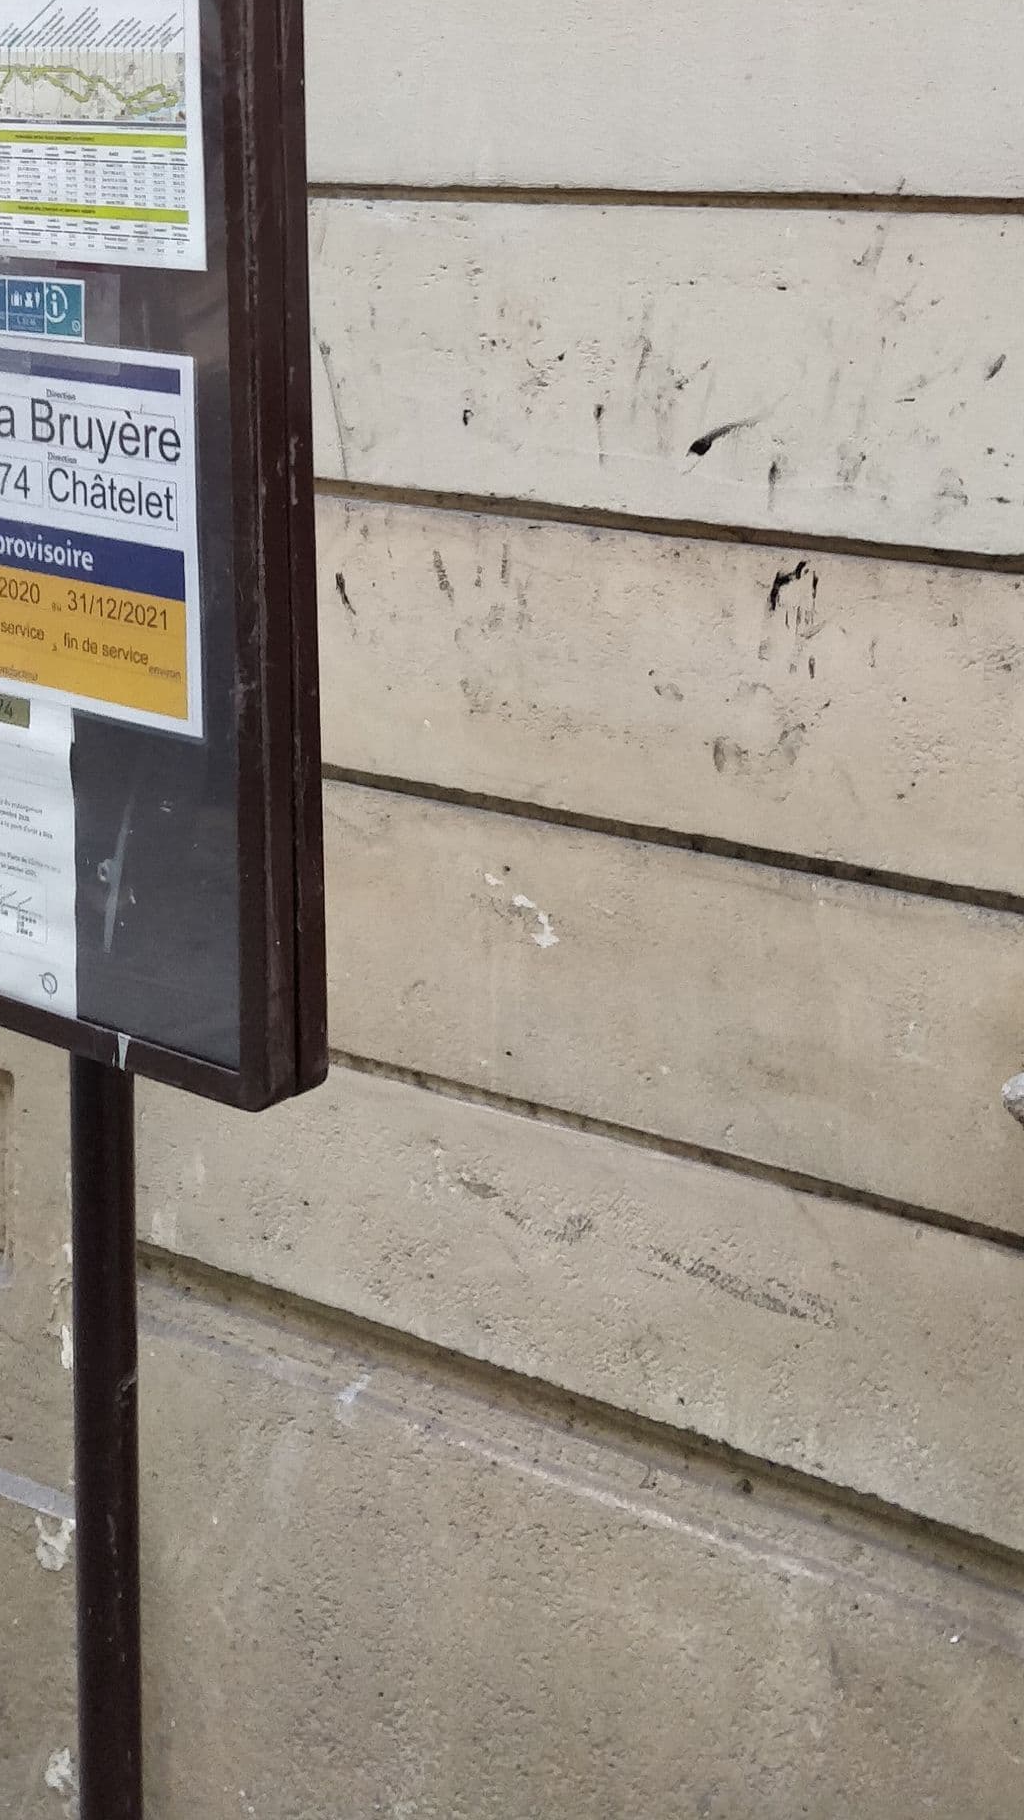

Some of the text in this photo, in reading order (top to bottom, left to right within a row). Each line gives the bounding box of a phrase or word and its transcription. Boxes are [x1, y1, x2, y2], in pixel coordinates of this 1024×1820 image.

[30, 397, 181, 464] Bruyère
[48, 467, 174, 522] Châtelet
[67, 589, 168, 631] 31/12/2021
[0, 620, 45, 641] service
[63, 632, 79, 651] fin
[82, 637, 98, 655] de
[101, 643, 149, 665] service
